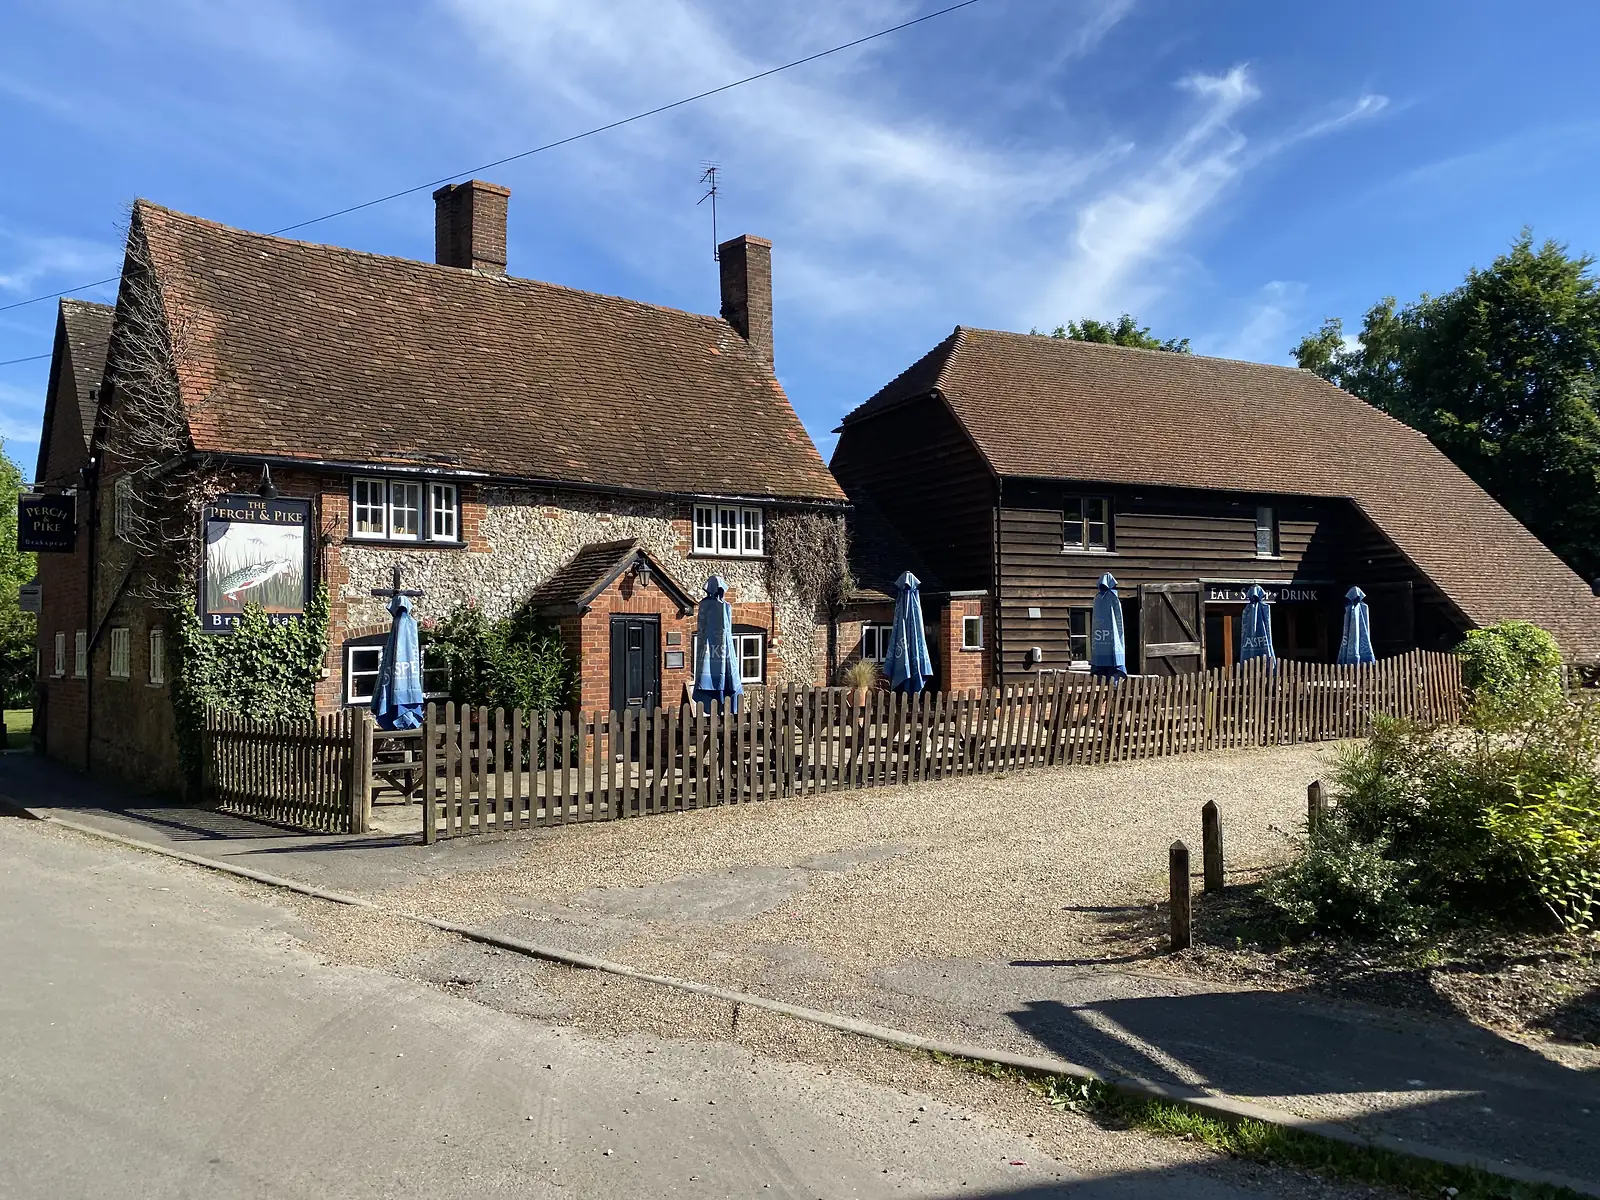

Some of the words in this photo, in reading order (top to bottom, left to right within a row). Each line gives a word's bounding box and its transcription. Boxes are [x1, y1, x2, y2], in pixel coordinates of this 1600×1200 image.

[247, 501, 266, 509] THE
[26, 507, 68, 520] PERCH
[210, 507, 254, 520] PERCH
[259, 510, 270, 520] &
[274, 510, 304, 522] PIKE
[33, 521, 61, 532] PIKE
[1210, 587, 1231, 600] EAT
[1281, 588, 1319, 600] DRINK
